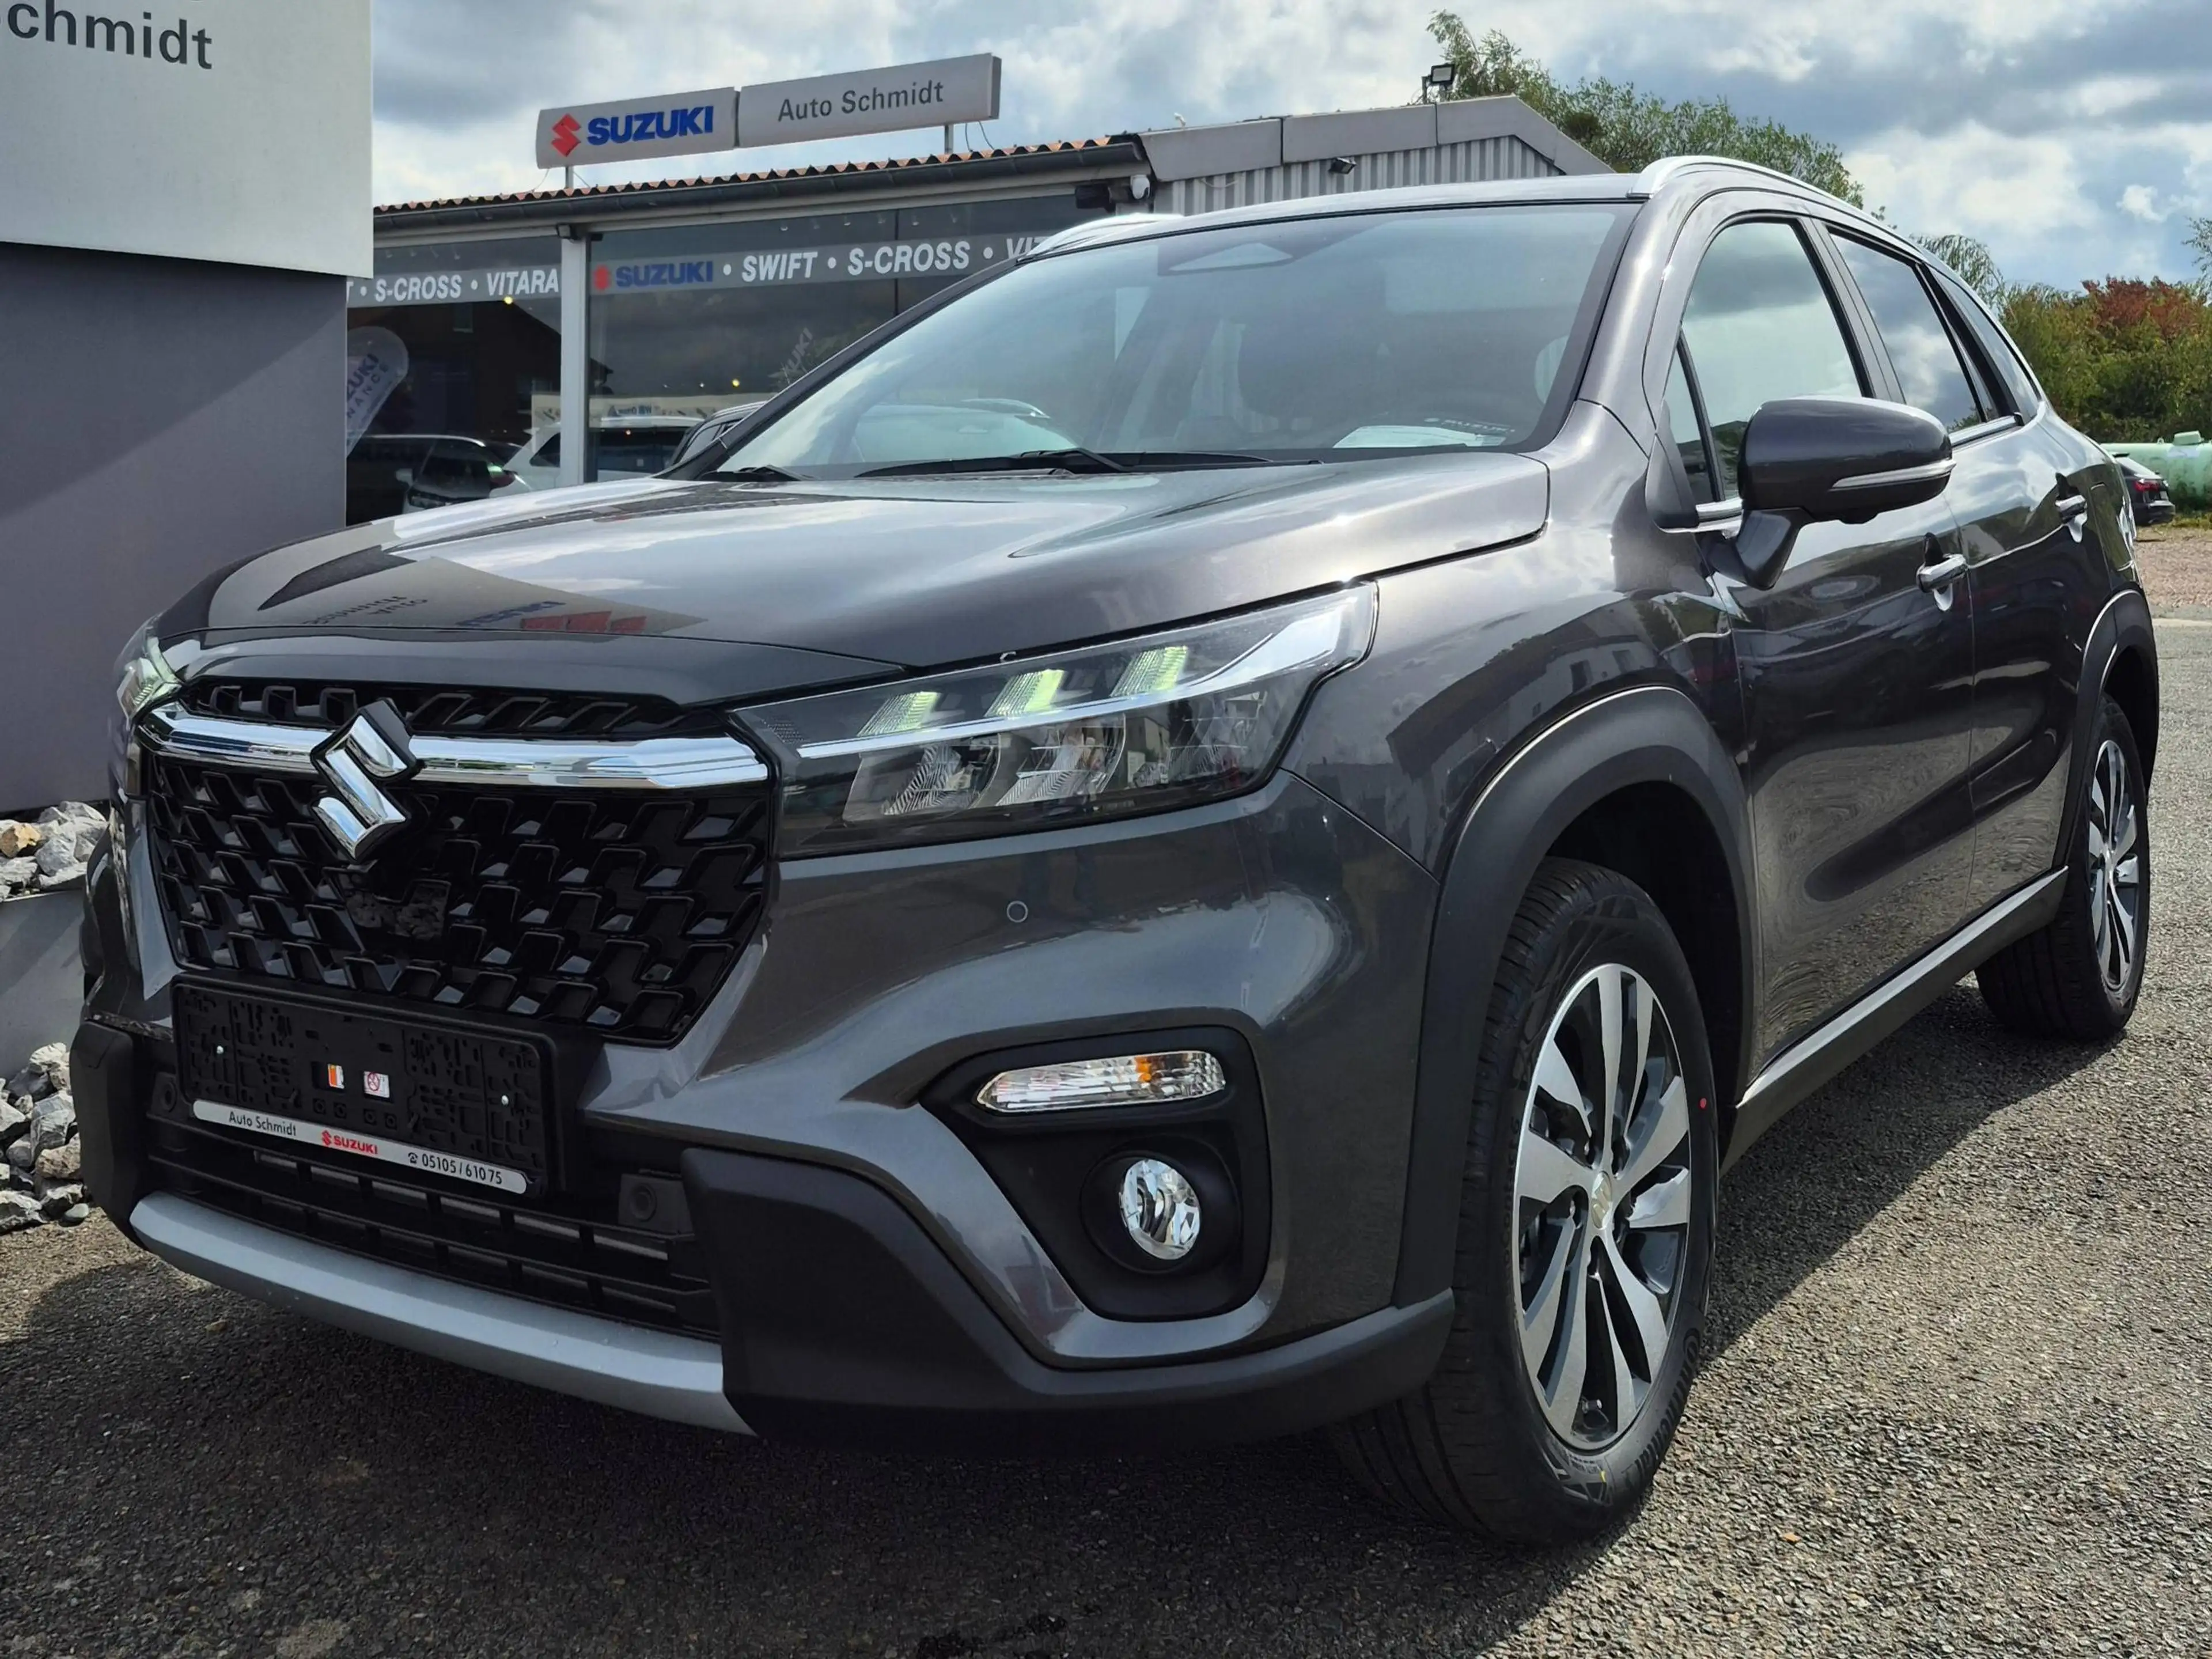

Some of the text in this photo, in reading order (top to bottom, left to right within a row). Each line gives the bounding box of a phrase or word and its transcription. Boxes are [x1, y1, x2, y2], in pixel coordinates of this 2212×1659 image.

[0, 0, 212, 69] chmidt
[778, 81, 944, 122] Auto Schmidt
[587, 105, 714, 145] SUZUKI
[374, 274, 462, 302] S-CROSS
[487, 268, 559, 296] VITARA
[616, 261, 714, 288] SUZUKI
[741, 252, 818, 282] SWIFT
[847, 241, 971, 276] S-CROSS
[229, 1111, 252, 1127] Auto
[256, 1116, 296, 1136] Schmidt
[334, 1135, 378, 1154] SUZUKI
